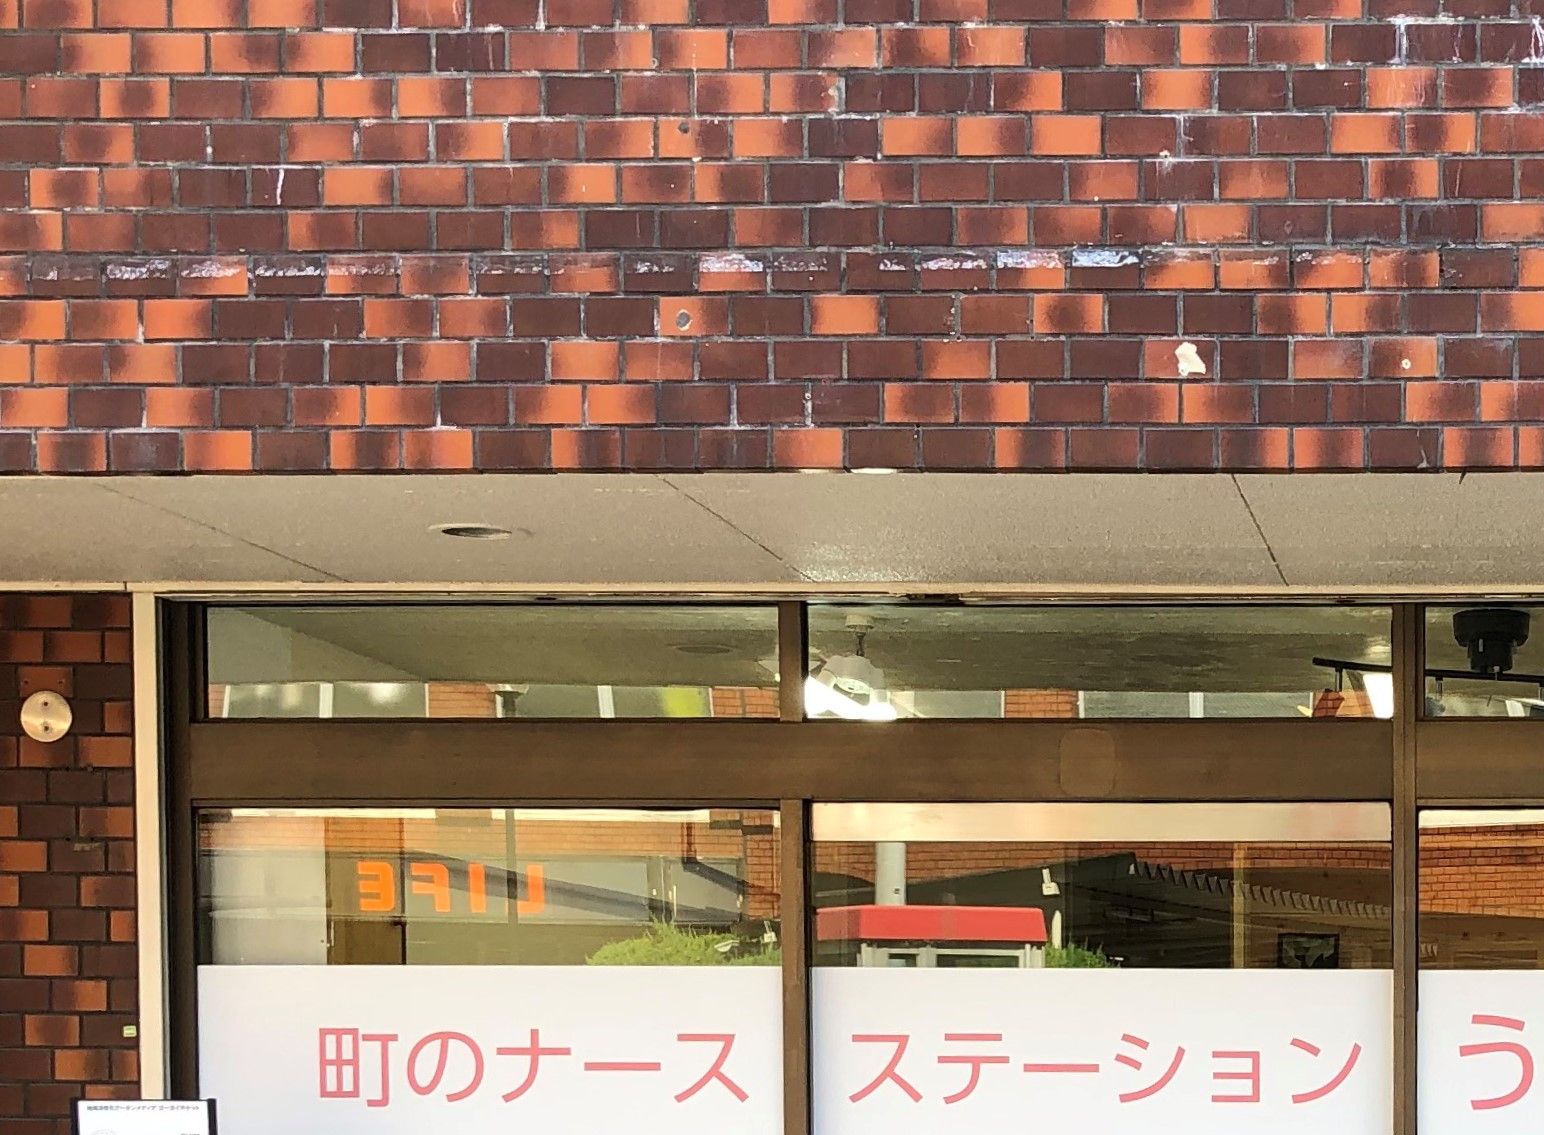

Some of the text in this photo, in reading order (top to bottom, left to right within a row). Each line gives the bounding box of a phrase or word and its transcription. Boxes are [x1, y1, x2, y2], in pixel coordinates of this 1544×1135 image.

[318, 1027, 748, 1108] 町のナース
[849, 1032, 1362, 1105] ステーション
